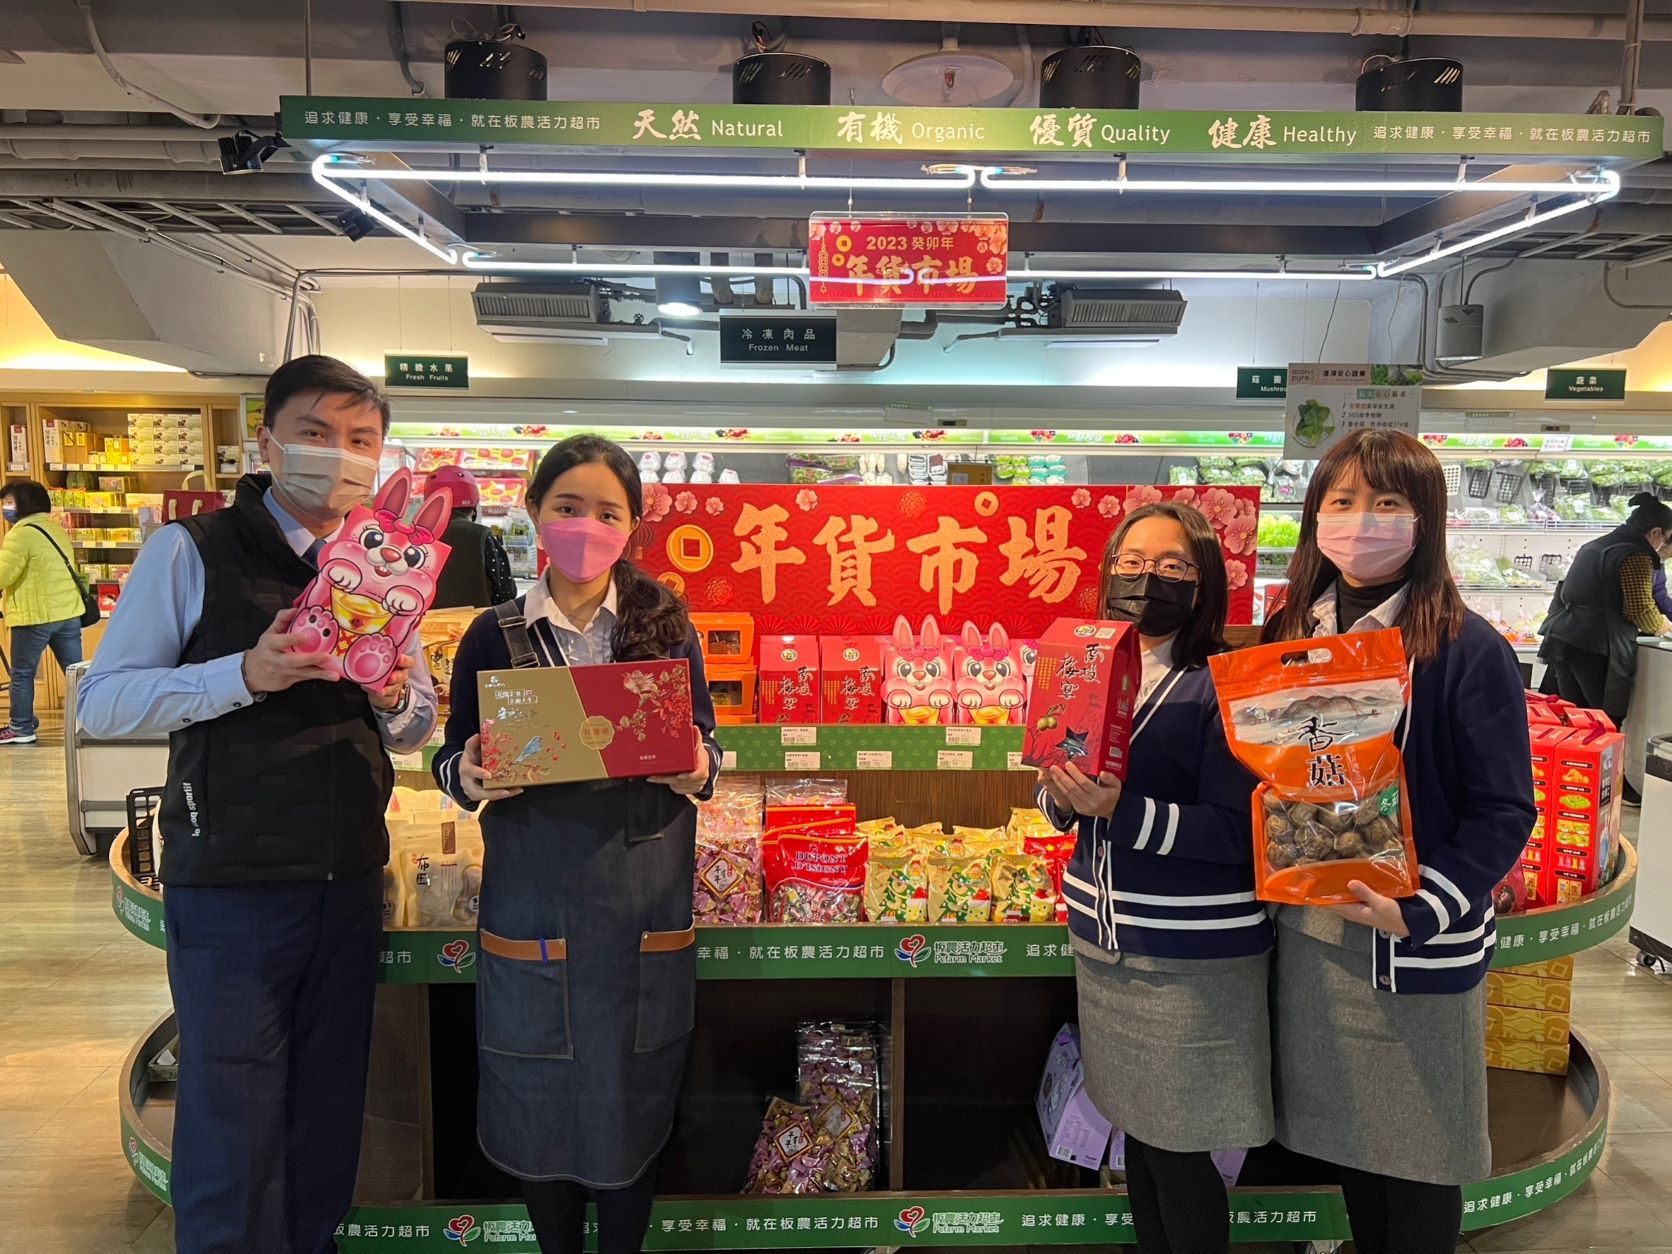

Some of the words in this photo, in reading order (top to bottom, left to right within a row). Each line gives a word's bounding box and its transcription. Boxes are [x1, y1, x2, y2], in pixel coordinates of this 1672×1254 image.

[632, 108, 702, 141] 天然
[711, 119, 784, 138] Natural
[836, 111, 903, 144] 有機
[911, 121, 985, 145] Organic
[1029, 112, 1099, 148] 優質
[1101, 123, 1171, 145] Quality
[1207, 114, 1277, 150] 健康
[1282, 125, 1357, 147] Healthy
[866, 236, 908, 250] 2023
[911, 236, 954, 251] 癸卯年
[845, 254, 978, 296] 年貨市場
[741, 328, 815, 341] 冷凍肉品
[748, 343, 779, 352] Frozen
[786, 343, 809, 352] Meat
[405, 373, 425, 381] Fresh
[1568, 385, 1604, 393] Vegetables
[731, 502, 1088, 616] 年貨市場
[1298, 716, 1352, 787] 香菇
[182, 782, 197, 811] sportif
[795, 851, 849, 863] DUPONT
[793, 861, 848, 875] D'ISIGNY
[968, 953, 1003, 963] Market
[483, 1220, 534, 1234] 板農活力
[966, 1224, 1000, 1233] Market
